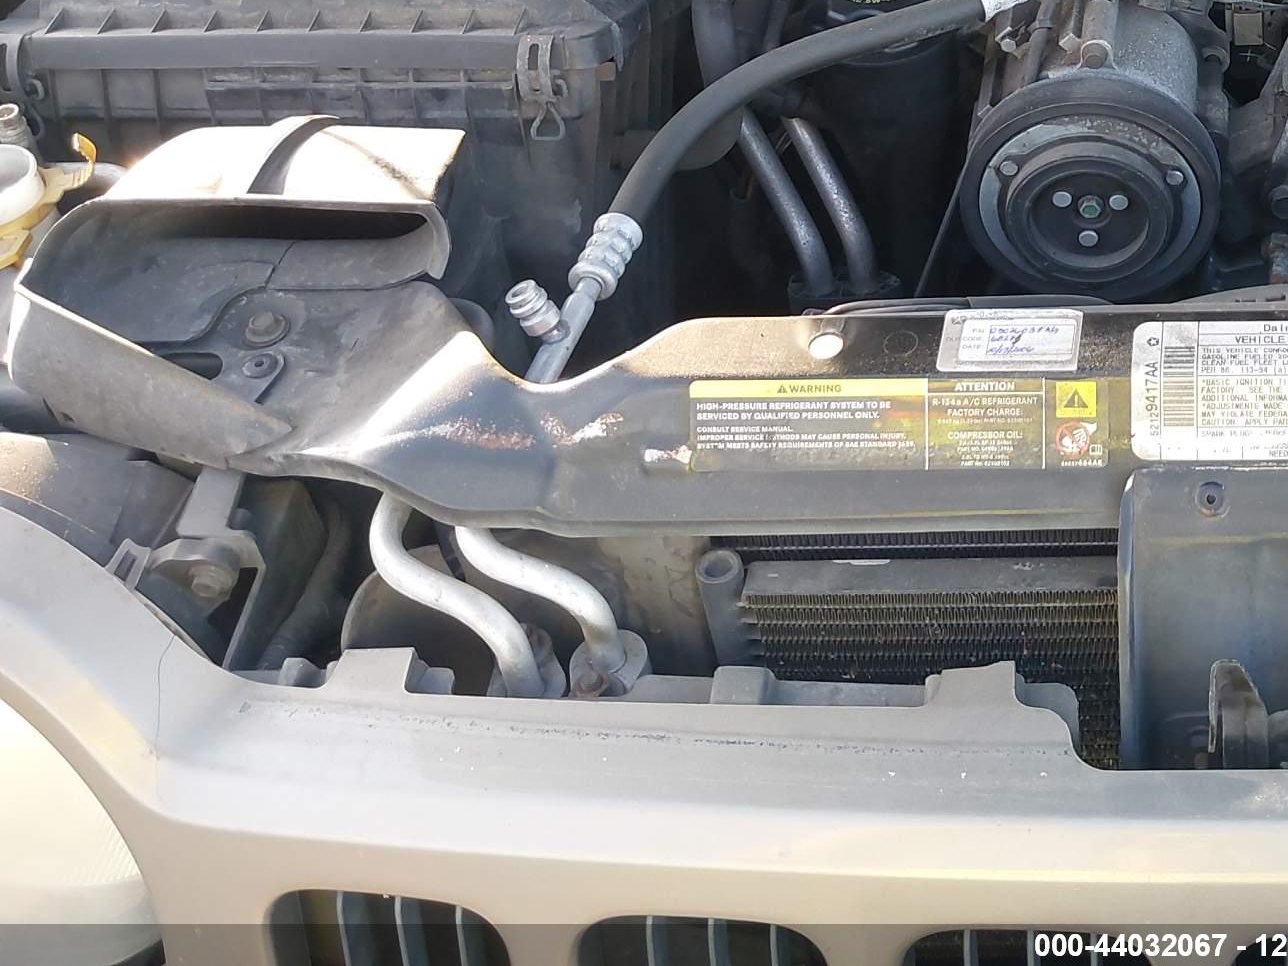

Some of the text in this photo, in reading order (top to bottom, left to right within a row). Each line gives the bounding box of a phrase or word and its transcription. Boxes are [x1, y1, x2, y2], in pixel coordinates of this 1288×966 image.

[1234, 335, 1287, 344] VEHICLE
[789, 384, 842, 393] WARNING
[954, 382, 1015, 392] ATTENTION
[932, 397, 1038, 406] R-134a A/C REFRIGERANT
[1202, 394, 1250, 402] ADDITIONAL
[769, 402, 829, 410] REFRIGERANT
[830, 401, 865, 409] SYSTEM
[866, 401, 878, 409] TO
[880, 401, 891, 409] BE
[1264, 402, 1284, 410] MADE
[741, 412, 752, 420] BY
[754, 412, 800, 420] QUALIFIED
[855, 411, 880, 419] ONLY.
[947, 408, 1023, 417] FACTORY CHARGE:
[1202, 410, 1216, 418] MAY
[1220, 410, 1254, 418] VIOLATE
[947, 431, 1023, 440] COMPRESSOR OIL:
